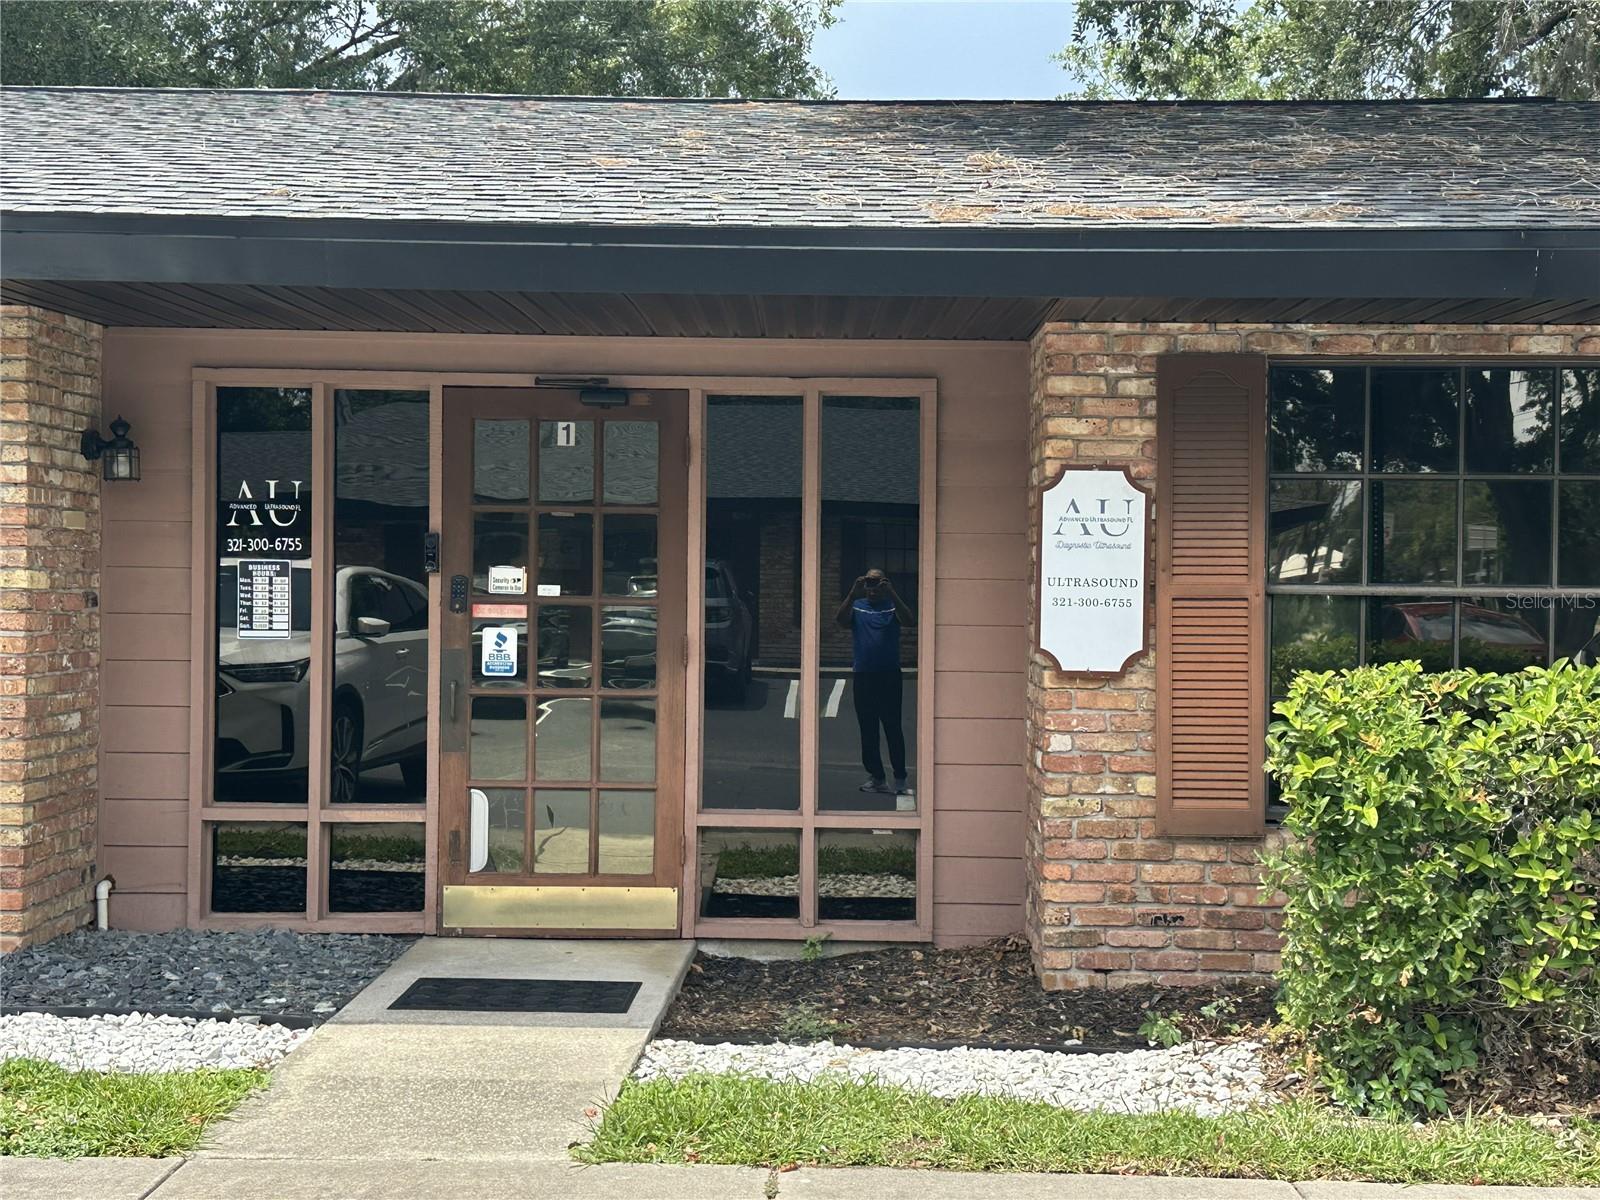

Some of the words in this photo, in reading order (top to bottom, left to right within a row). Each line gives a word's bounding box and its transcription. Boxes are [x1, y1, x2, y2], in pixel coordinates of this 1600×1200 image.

[561, 423, 571, 445] 1
[264, 503, 295, 511] ULTRASOUND
[227, 537, 302, 552] 321-300-6755
[1055, 540, 1091, 551] Diagnostic
[1093, 540, 1132, 550] Ultrasound
[492, 576, 509, 584] Security
[1047, 577, 1139, 589] ULTRASOUND
[1052, 597, 1133, 608] 321-300-6755
[488, 653, 511, 661] BBB
